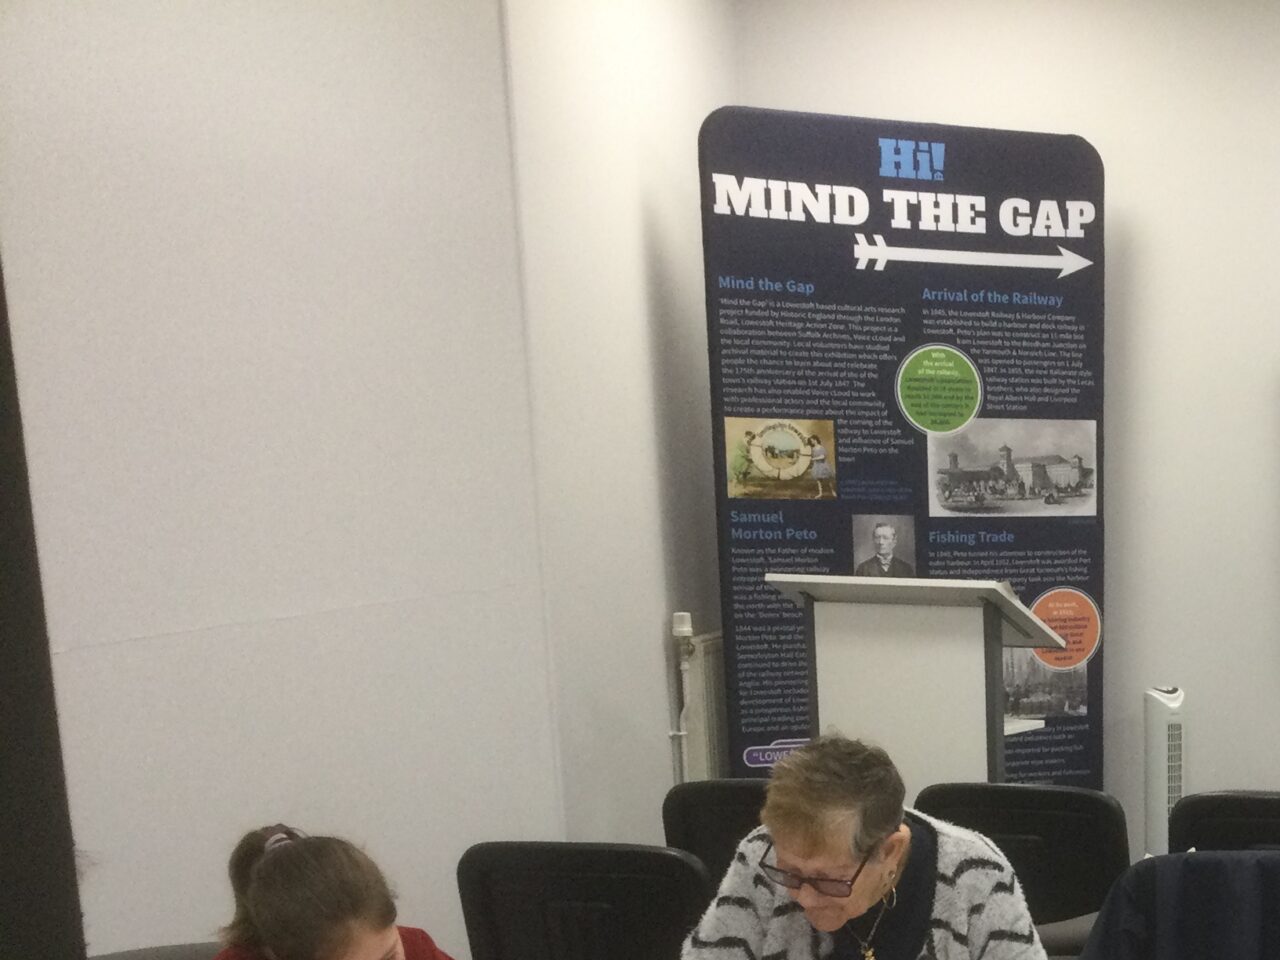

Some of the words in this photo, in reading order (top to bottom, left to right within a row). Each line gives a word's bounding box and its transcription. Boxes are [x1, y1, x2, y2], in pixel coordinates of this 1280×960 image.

[878, 137, 946, 182] Hi!
[712, 172, 870, 226] MIND
[883, 189, 986, 234] THE
[998, 197, 1096, 239] GAP
[718, 276, 754, 290] Mind
[759, 278, 782, 291] the
[786, 280, 814, 296] Gap
[922, 288, 967, 302] Arrival
[971, 290, 984, 302] of
[987, 292, 1009, 304] the
[1012, 292, 1064, 308] Railway
[730, 511, 784, 522] Samuel
[731, 528, 782, 540] Morton
[786, 528, 818, 540] Peto
[928, 532, 976, 546] Fishing
[978, 531, 1014, 542] Trade
